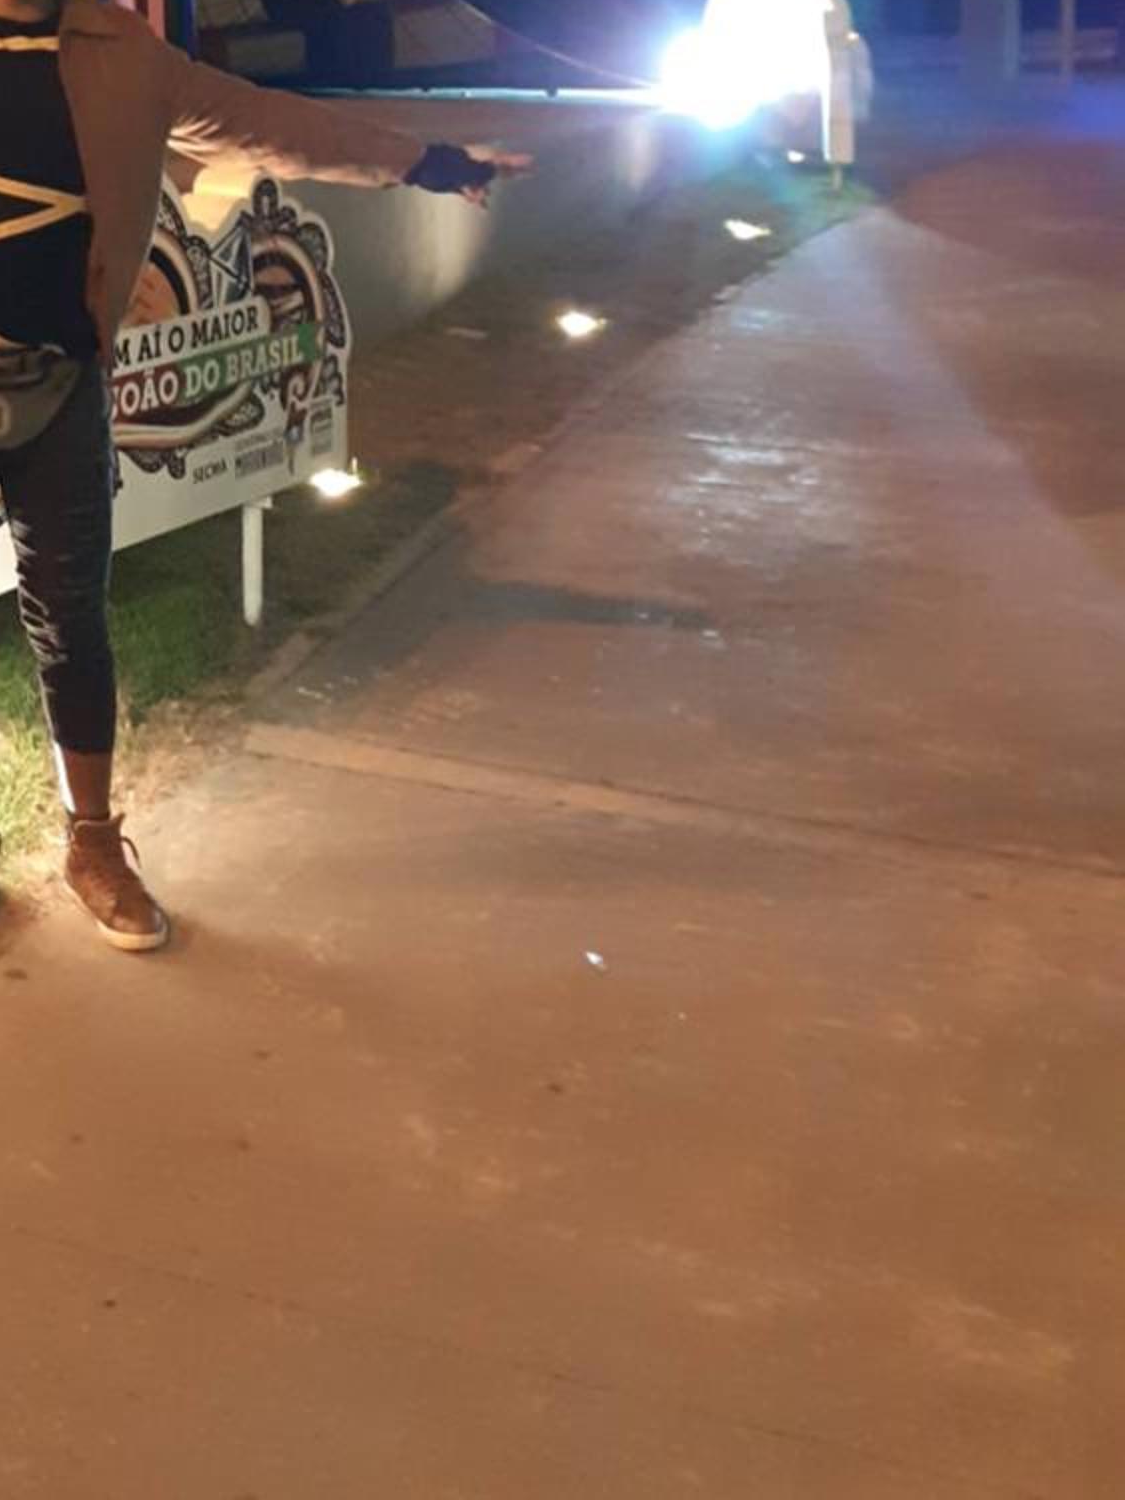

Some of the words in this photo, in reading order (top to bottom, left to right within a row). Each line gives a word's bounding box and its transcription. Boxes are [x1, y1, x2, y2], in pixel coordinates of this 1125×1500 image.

[168, 325, 185, 354] O
[191, 306, 259, 349] MAIOR
[185, 364, 220, 399] DO
[226, 334, 304, 385] BRASIL
